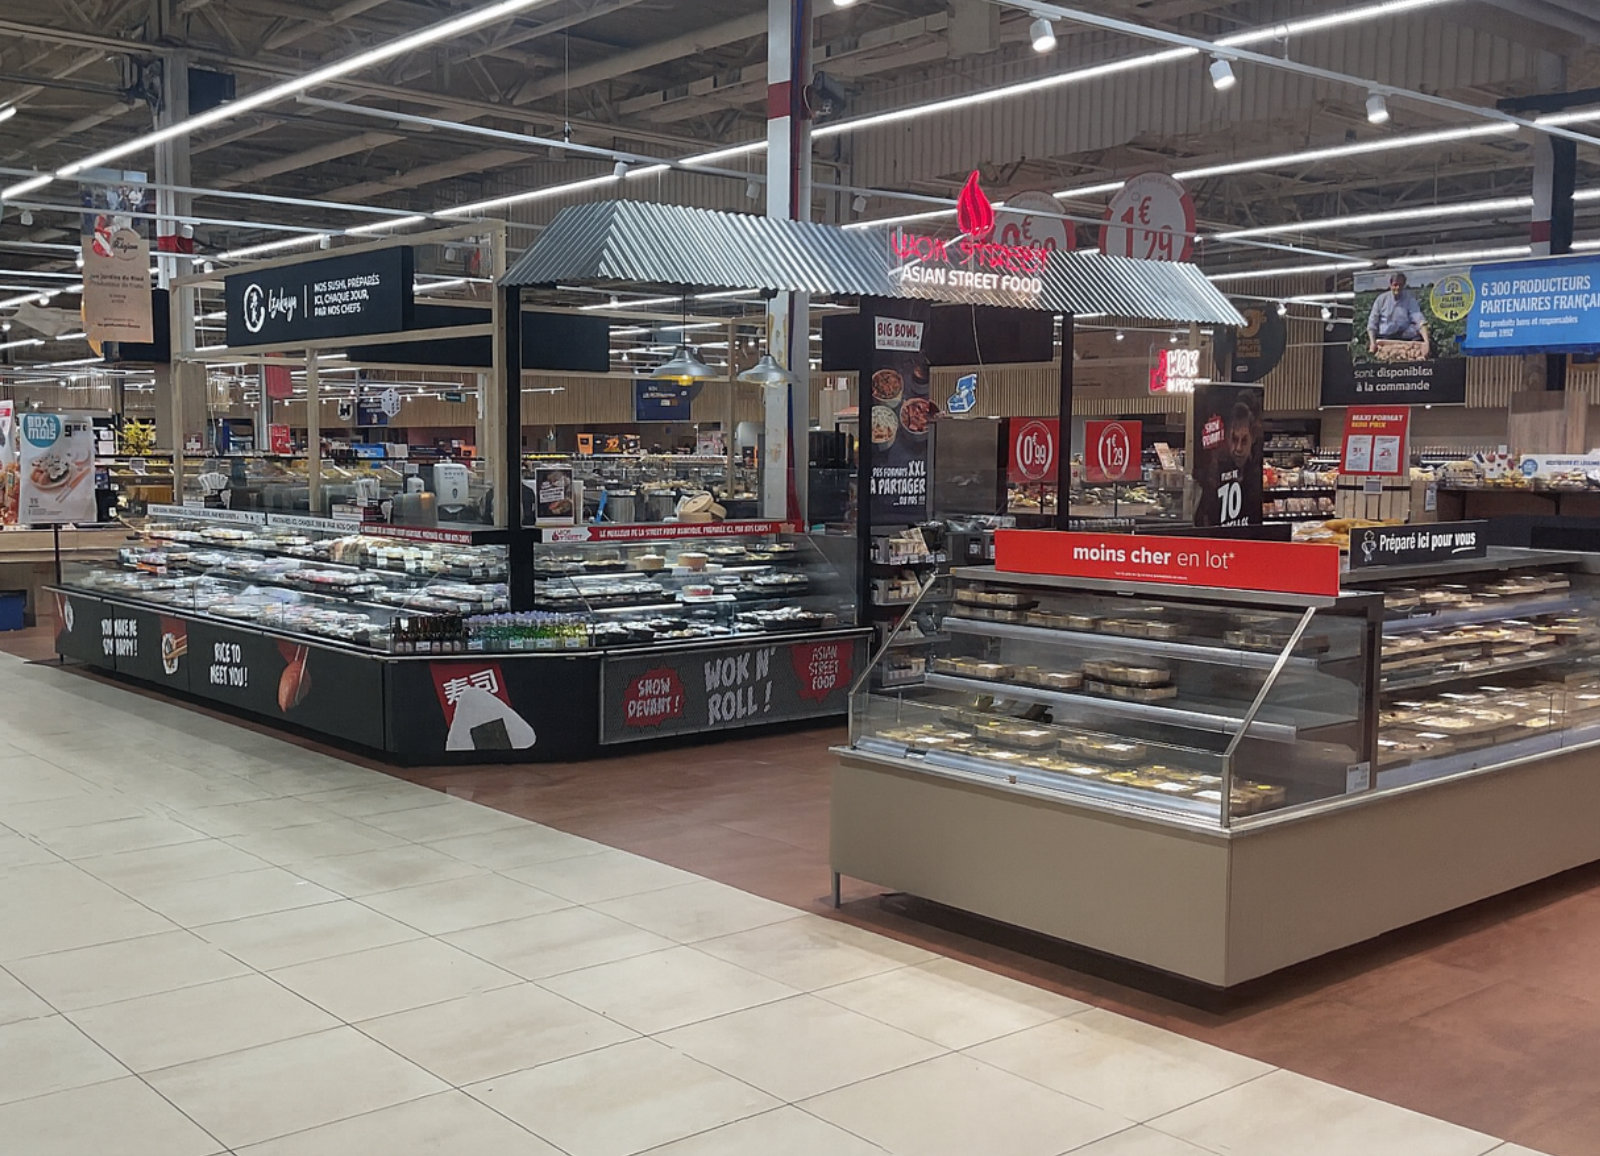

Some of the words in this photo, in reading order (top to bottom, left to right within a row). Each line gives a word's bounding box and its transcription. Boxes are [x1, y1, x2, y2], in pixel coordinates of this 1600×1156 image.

[902, 265, 946, 285] ASIAN
[948, 271, 999, 290] STREET
[1001, 276, 1043, 295] FOOD
[1481, 283, 1489, 296] 6
[1490, 281, 1511, 295] 300
[1512, 275, 1591, 294] PRODUCTEURS
[324, 290, 350, 304] CHAQUE
[1480, 295, 1551, 314] PARTENAIRES
[327, 304, 341, 316] NOS
[341, 302, 361, 314] CHEFS
[877, 322, 893, 337] BIG
[894, 323, 919, 340] BOWL,
[1353, 370, 1374, 378] sont
[1356, 381, 1363, 392] à
[1364, 382, 1374, 392] la
[1375, 380, 1430, 392] commande
[908, 460, 926, 477] XXL
[878, 478, 926, 495] PARTAGER
[1380, 532, 1416, 554] Préparé
[1417, 531, 1430, 549] ici
[1431, 534, 1453, 551] pour
[1454, 532, 1476, 546] vous
[1073, 544, 1126, 562] moins
[1130, 547, 1171, 565] cher
[1177, 553, 1200, 567] en
[231, 643, 241, 664] TO
[811, 645, 838, 661] ASIAN
[229, 666, 243, 687] YOU
[704, 653, 750, 692] WOK
[808, 660, 839, 677] STREET
[442, 668, 499, 705] 寿司
[637, 677, 671, 697] SHOW
[812, 674, 836, 690] FOOD
[627, 697, 671, 718] DEVANT
[708, 686, 758, 725] ROLL
